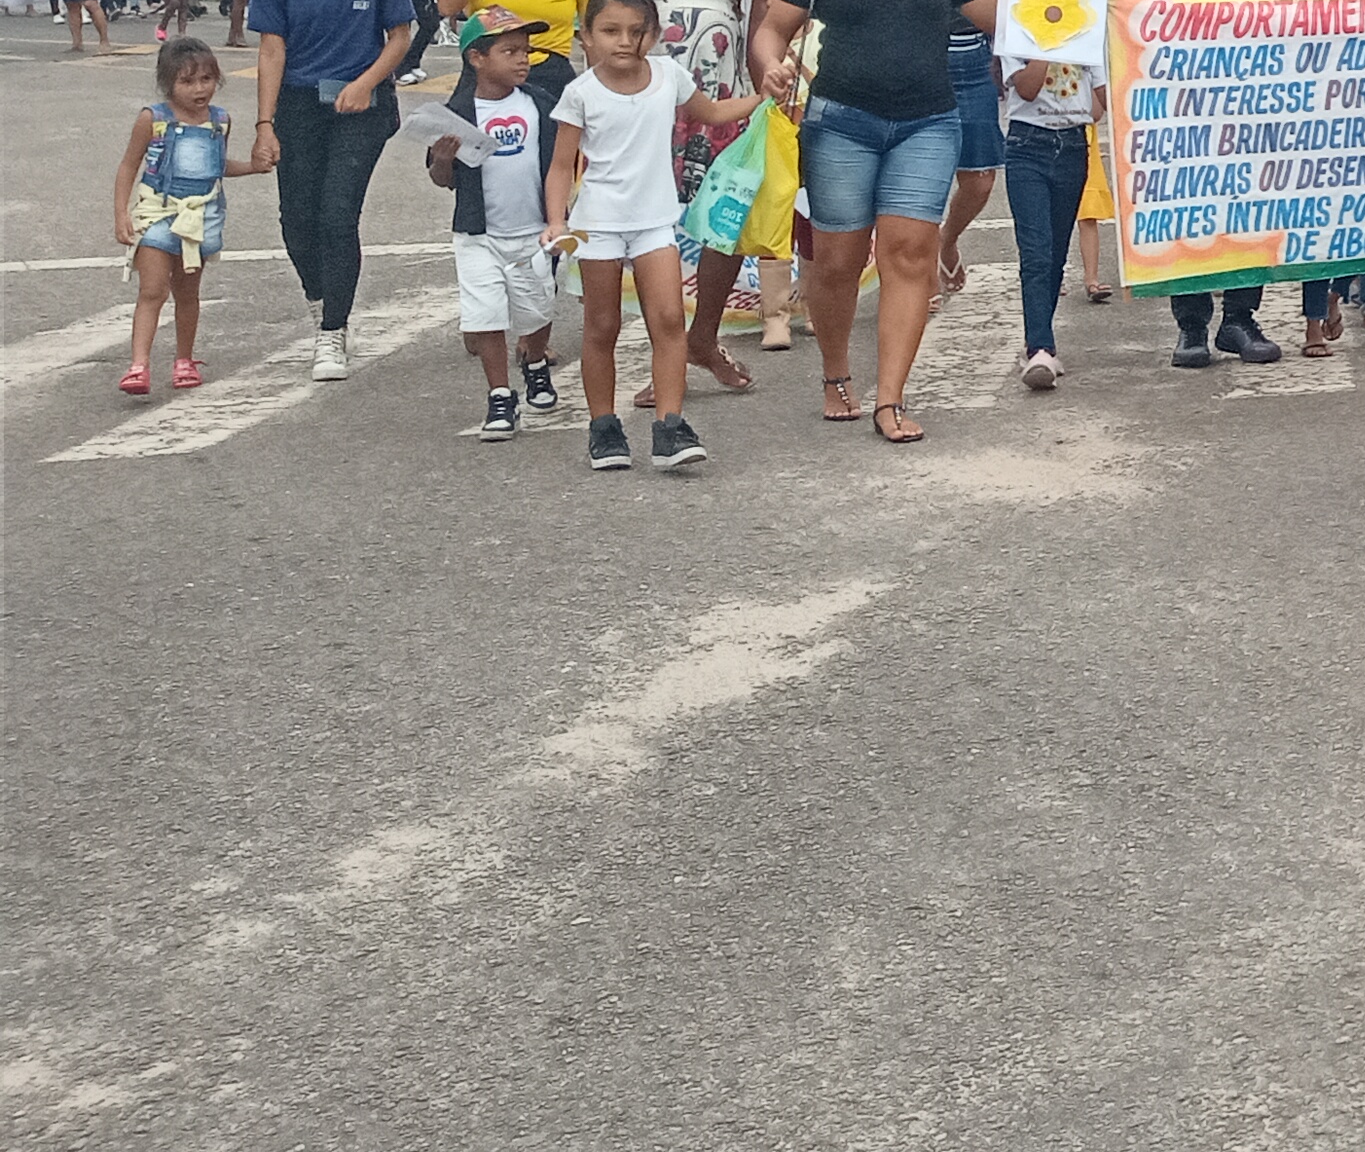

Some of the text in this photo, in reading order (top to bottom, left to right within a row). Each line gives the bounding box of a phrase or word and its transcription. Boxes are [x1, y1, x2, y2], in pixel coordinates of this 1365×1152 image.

[1149, 43, 1286, 81] CRIANÇAS
[1295, 41, 1332, 74] OU
[1131, 87, 1169, 122] UM
[1173, 80, 1317, 118] INTERESSE
[1130, 124, 1213, 165] FAÇAM
[1131, 161, 1252, 205] PALAVRAS
[1258, 159, 1294, 192] OU
[1133, 203, 1217, 246] PARTES
[1226, 195, 1332, 234] ÍNTIMAS
[1284, 230, 1321, 263] DE
